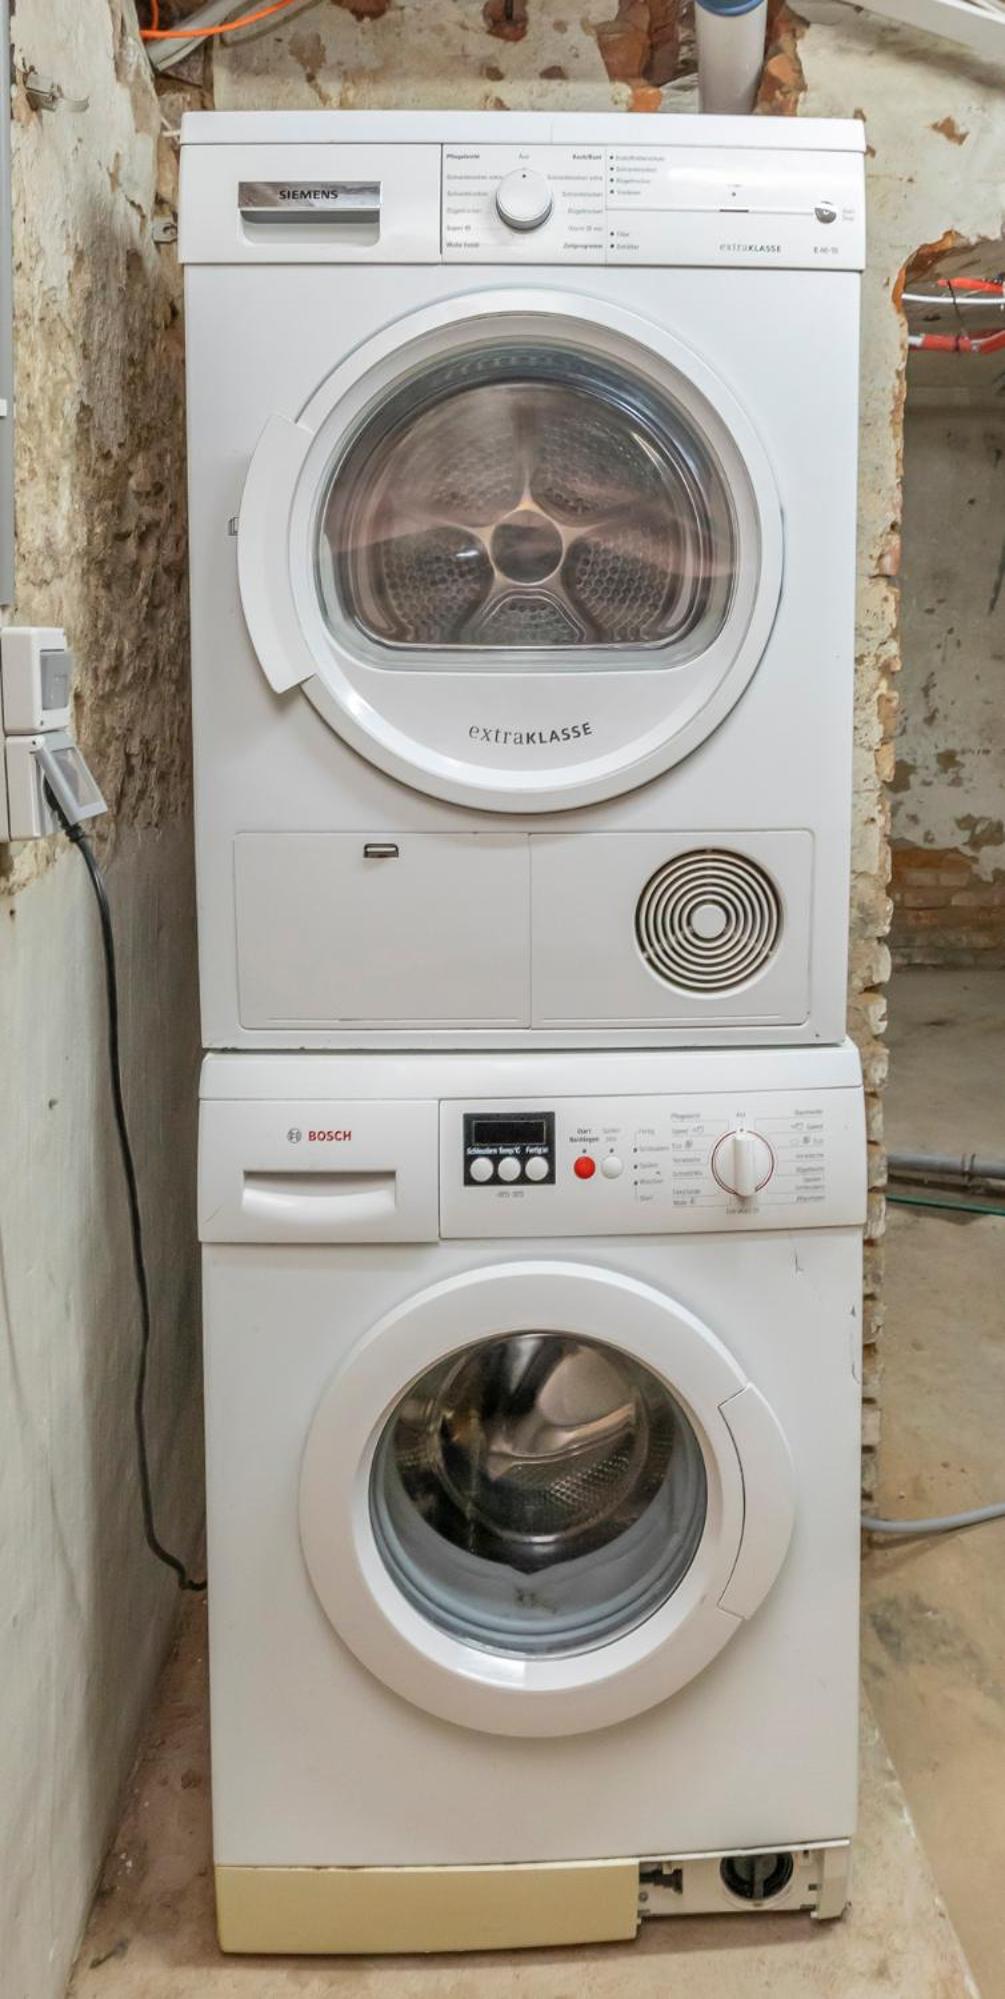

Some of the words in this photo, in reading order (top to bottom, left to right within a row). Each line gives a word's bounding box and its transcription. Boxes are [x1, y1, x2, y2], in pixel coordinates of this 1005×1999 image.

[279, 189, 339, 200] SIEMENS
[719, 243, 781, 253] extraKLASSE
[468, 721, 592, 745] extraKLASSE
[308, 1130, 352, 1141] BOSCH
